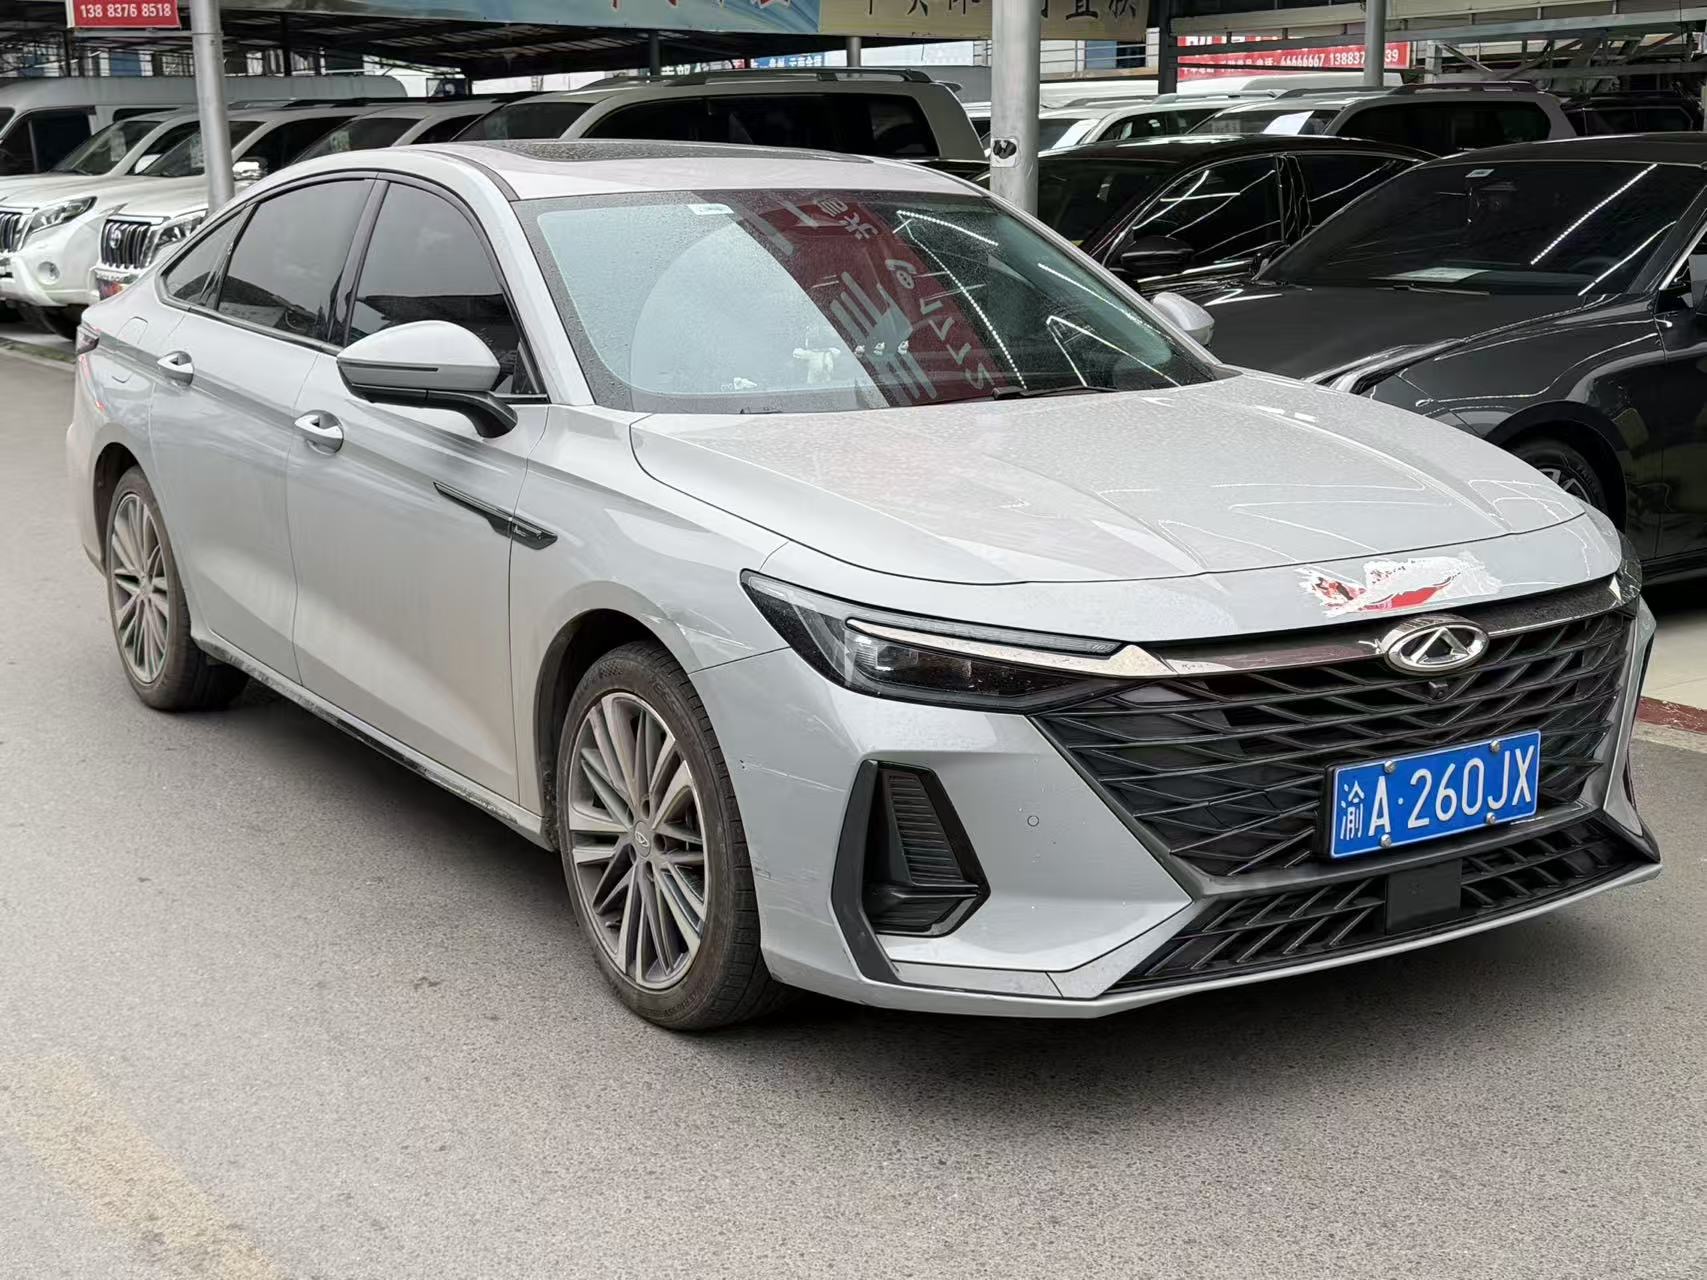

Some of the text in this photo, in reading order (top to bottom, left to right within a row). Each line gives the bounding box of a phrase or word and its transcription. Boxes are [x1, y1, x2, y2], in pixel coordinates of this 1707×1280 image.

[80, 3, 171, 18] 138 8376 8518
[1329, 49, 1399, 66] 13883739
